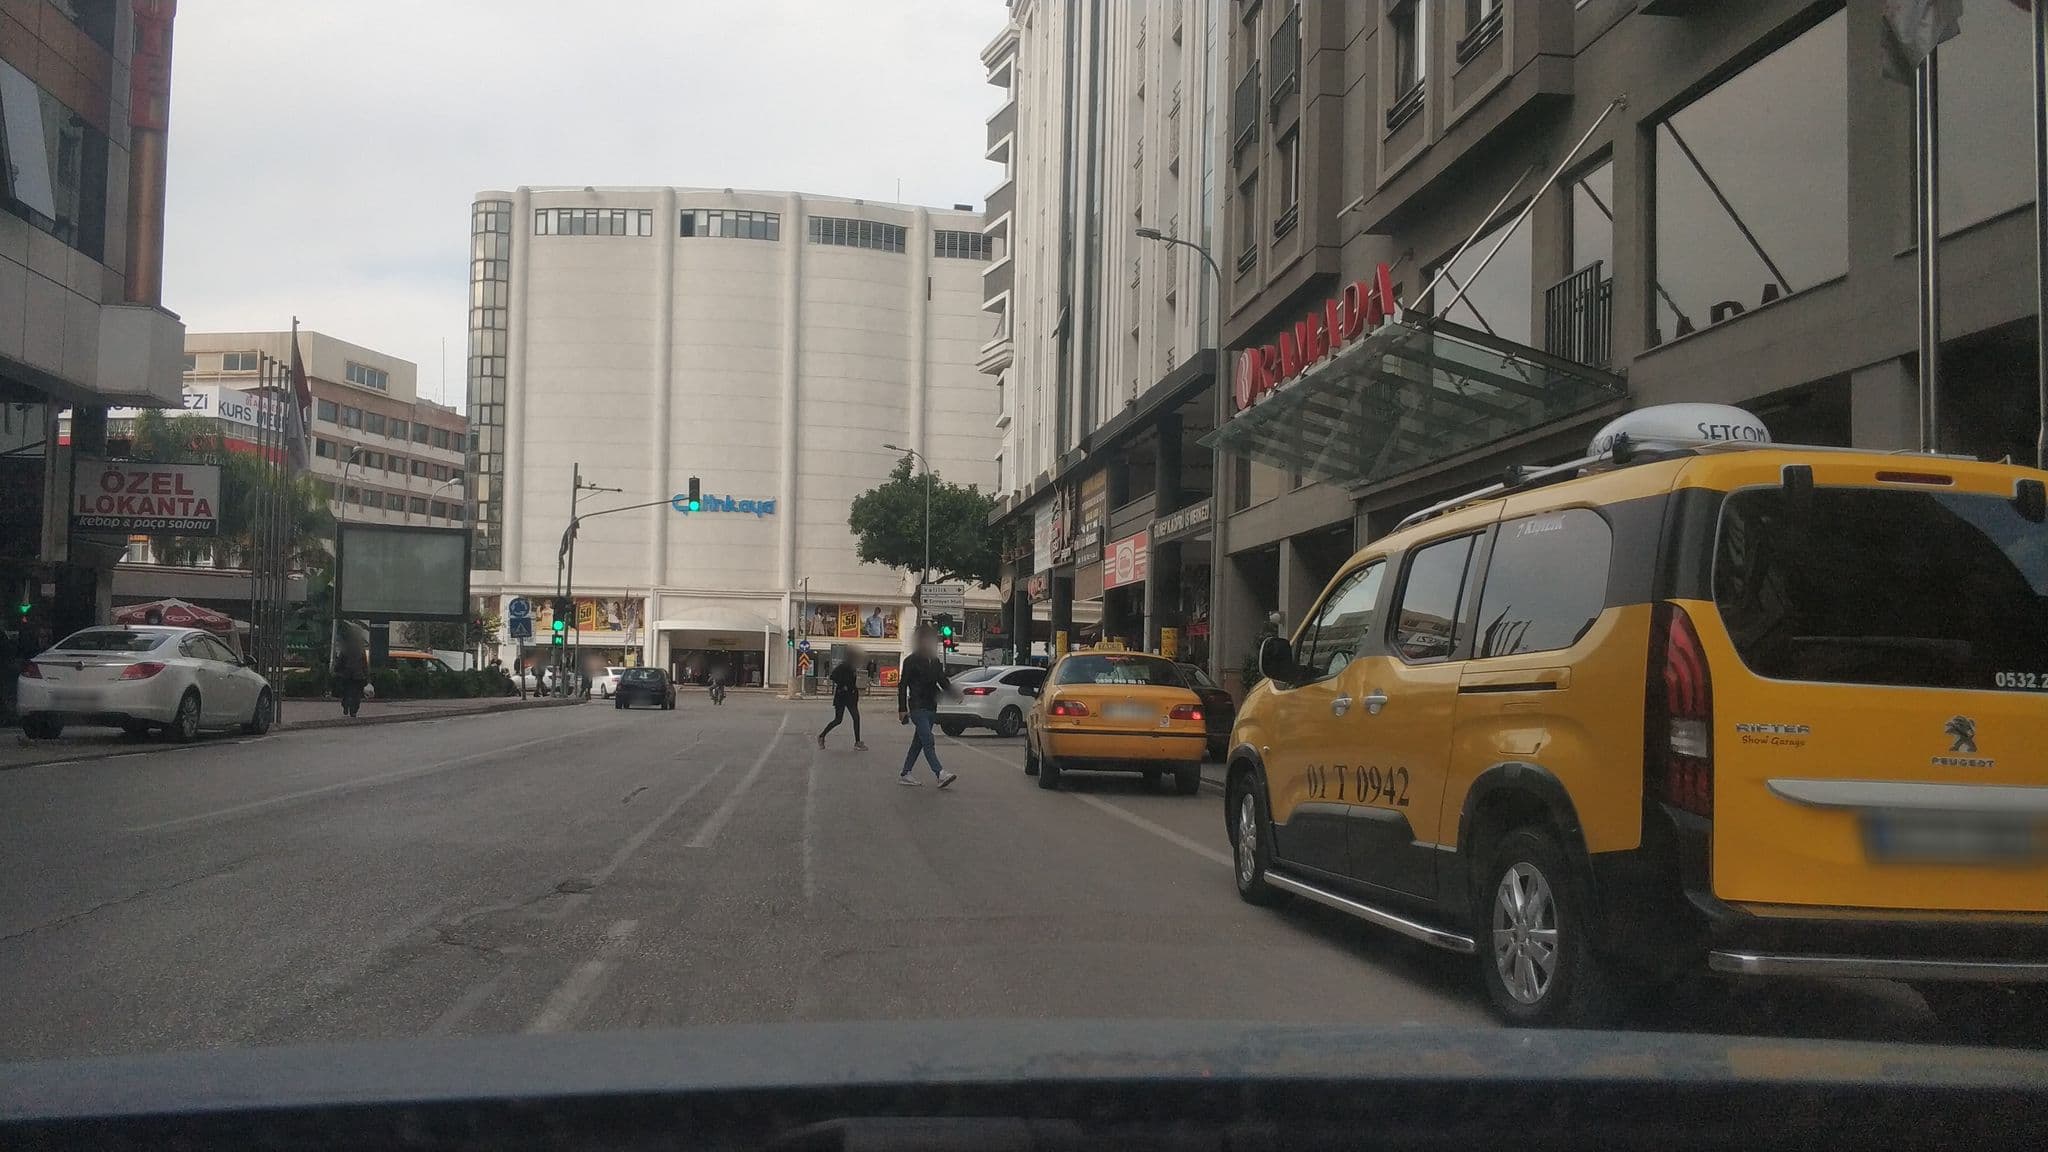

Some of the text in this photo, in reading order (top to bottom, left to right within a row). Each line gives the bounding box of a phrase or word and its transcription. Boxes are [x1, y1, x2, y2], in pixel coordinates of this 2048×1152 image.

[219, 402, 252, 421] KURS
[1697, 422, 1766, 443] SETCOM
[101, 465, 194, 495] ÖZEL
[79, 494, 213, 518] LOKANTA
[671, 493, 777, 518] Çtinkaya
[79, 516, 121, 528] kebap
[133, 518, 165, 530] paça
[167, 518, 211, 530] salonu
[1735, 722, 1811, 735] RIFTER
[1741, 734, 1806, 748] Show Garage
[1931, 756, 1995, 769] PEUGEOT
[1307, 764, 1409, 807] 01 T 0942
